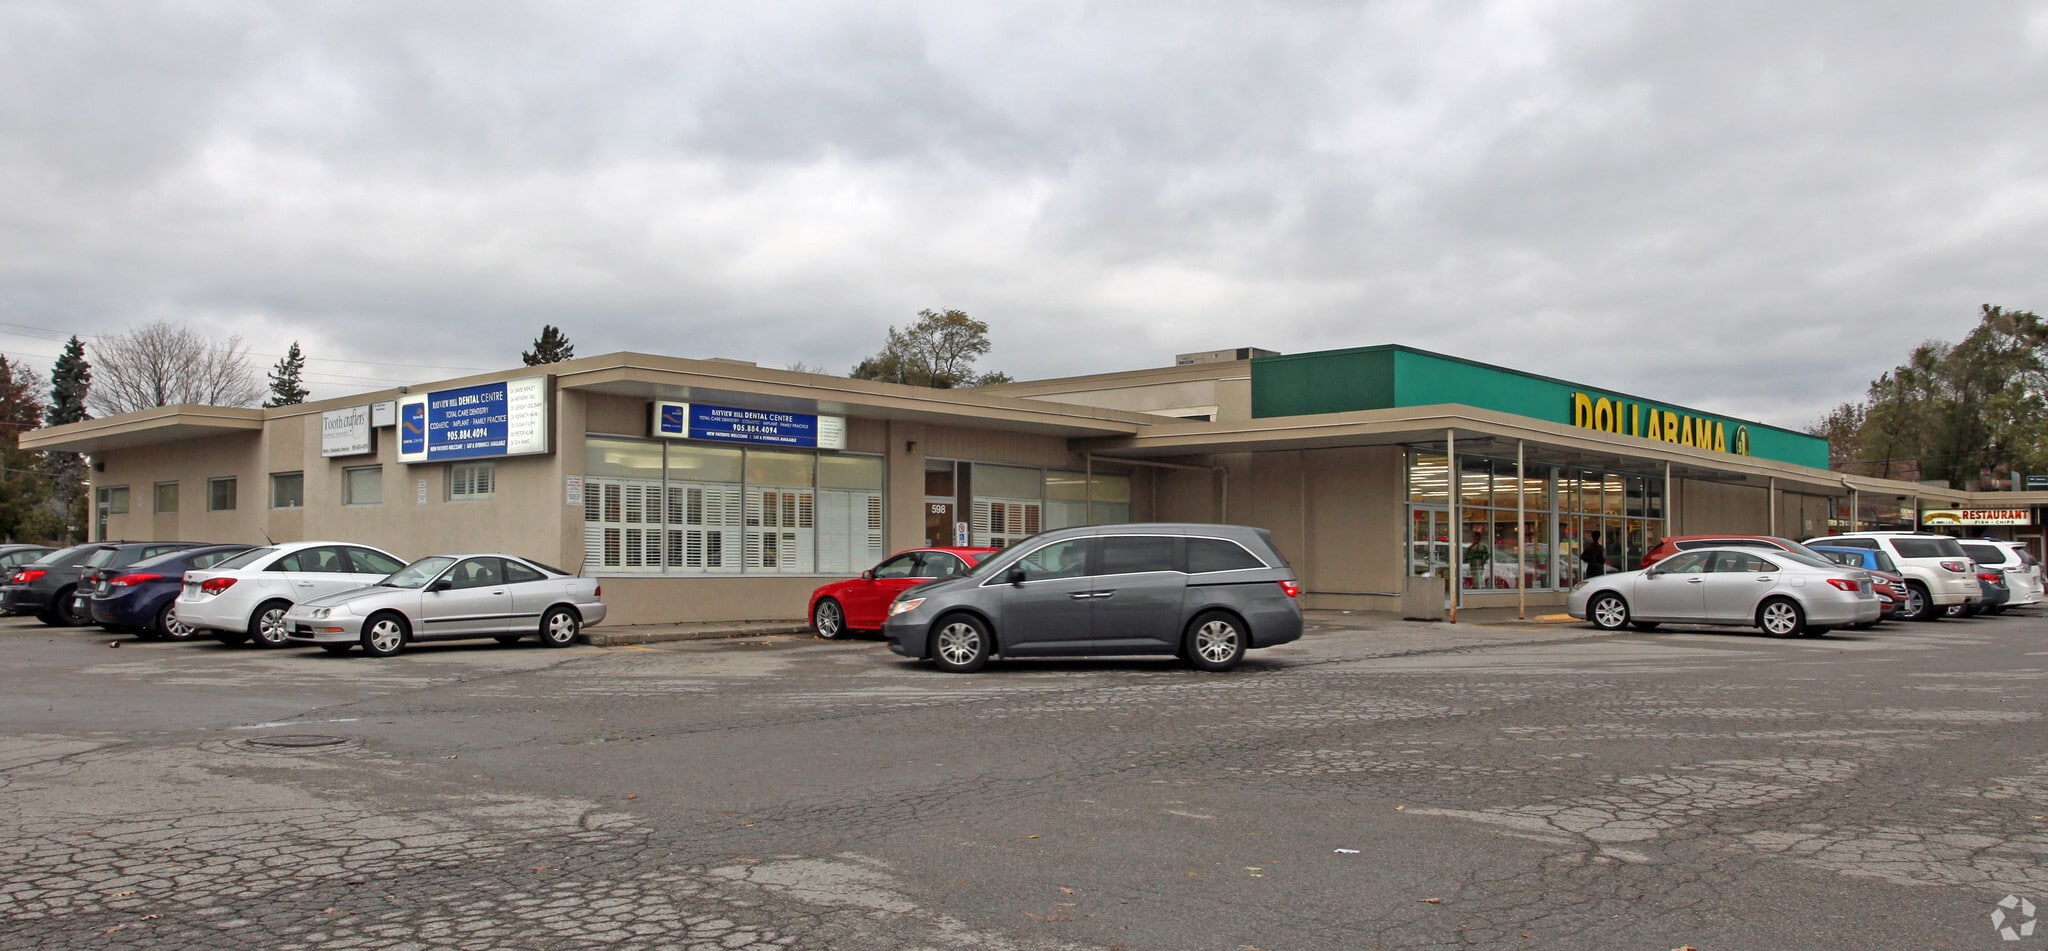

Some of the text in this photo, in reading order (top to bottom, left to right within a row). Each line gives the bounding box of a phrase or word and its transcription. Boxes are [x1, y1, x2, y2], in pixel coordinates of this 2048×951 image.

[458, 394, 480, 406] DENTAL
[480, 391, 503, 403] CENTRE
[445, 410, 457, 418] TOTAL
[457, 408, 469, 417] CARE
[744, 411, 768, 420] DENTAL
[769, 414, 793, 422] CENTRE
[323, 416, 343, 430] Tooth
[473, 416, 486, 425] FAMILY
[486, 415, 507, 424] PRACTICE
[447, 427, 488, 441] 905.884.4094
[732, 423, 778, 434] 905.884.4094
[931, 504, 946, 514] 598
[1962, 509, 2028, 520] RESTAURANT
